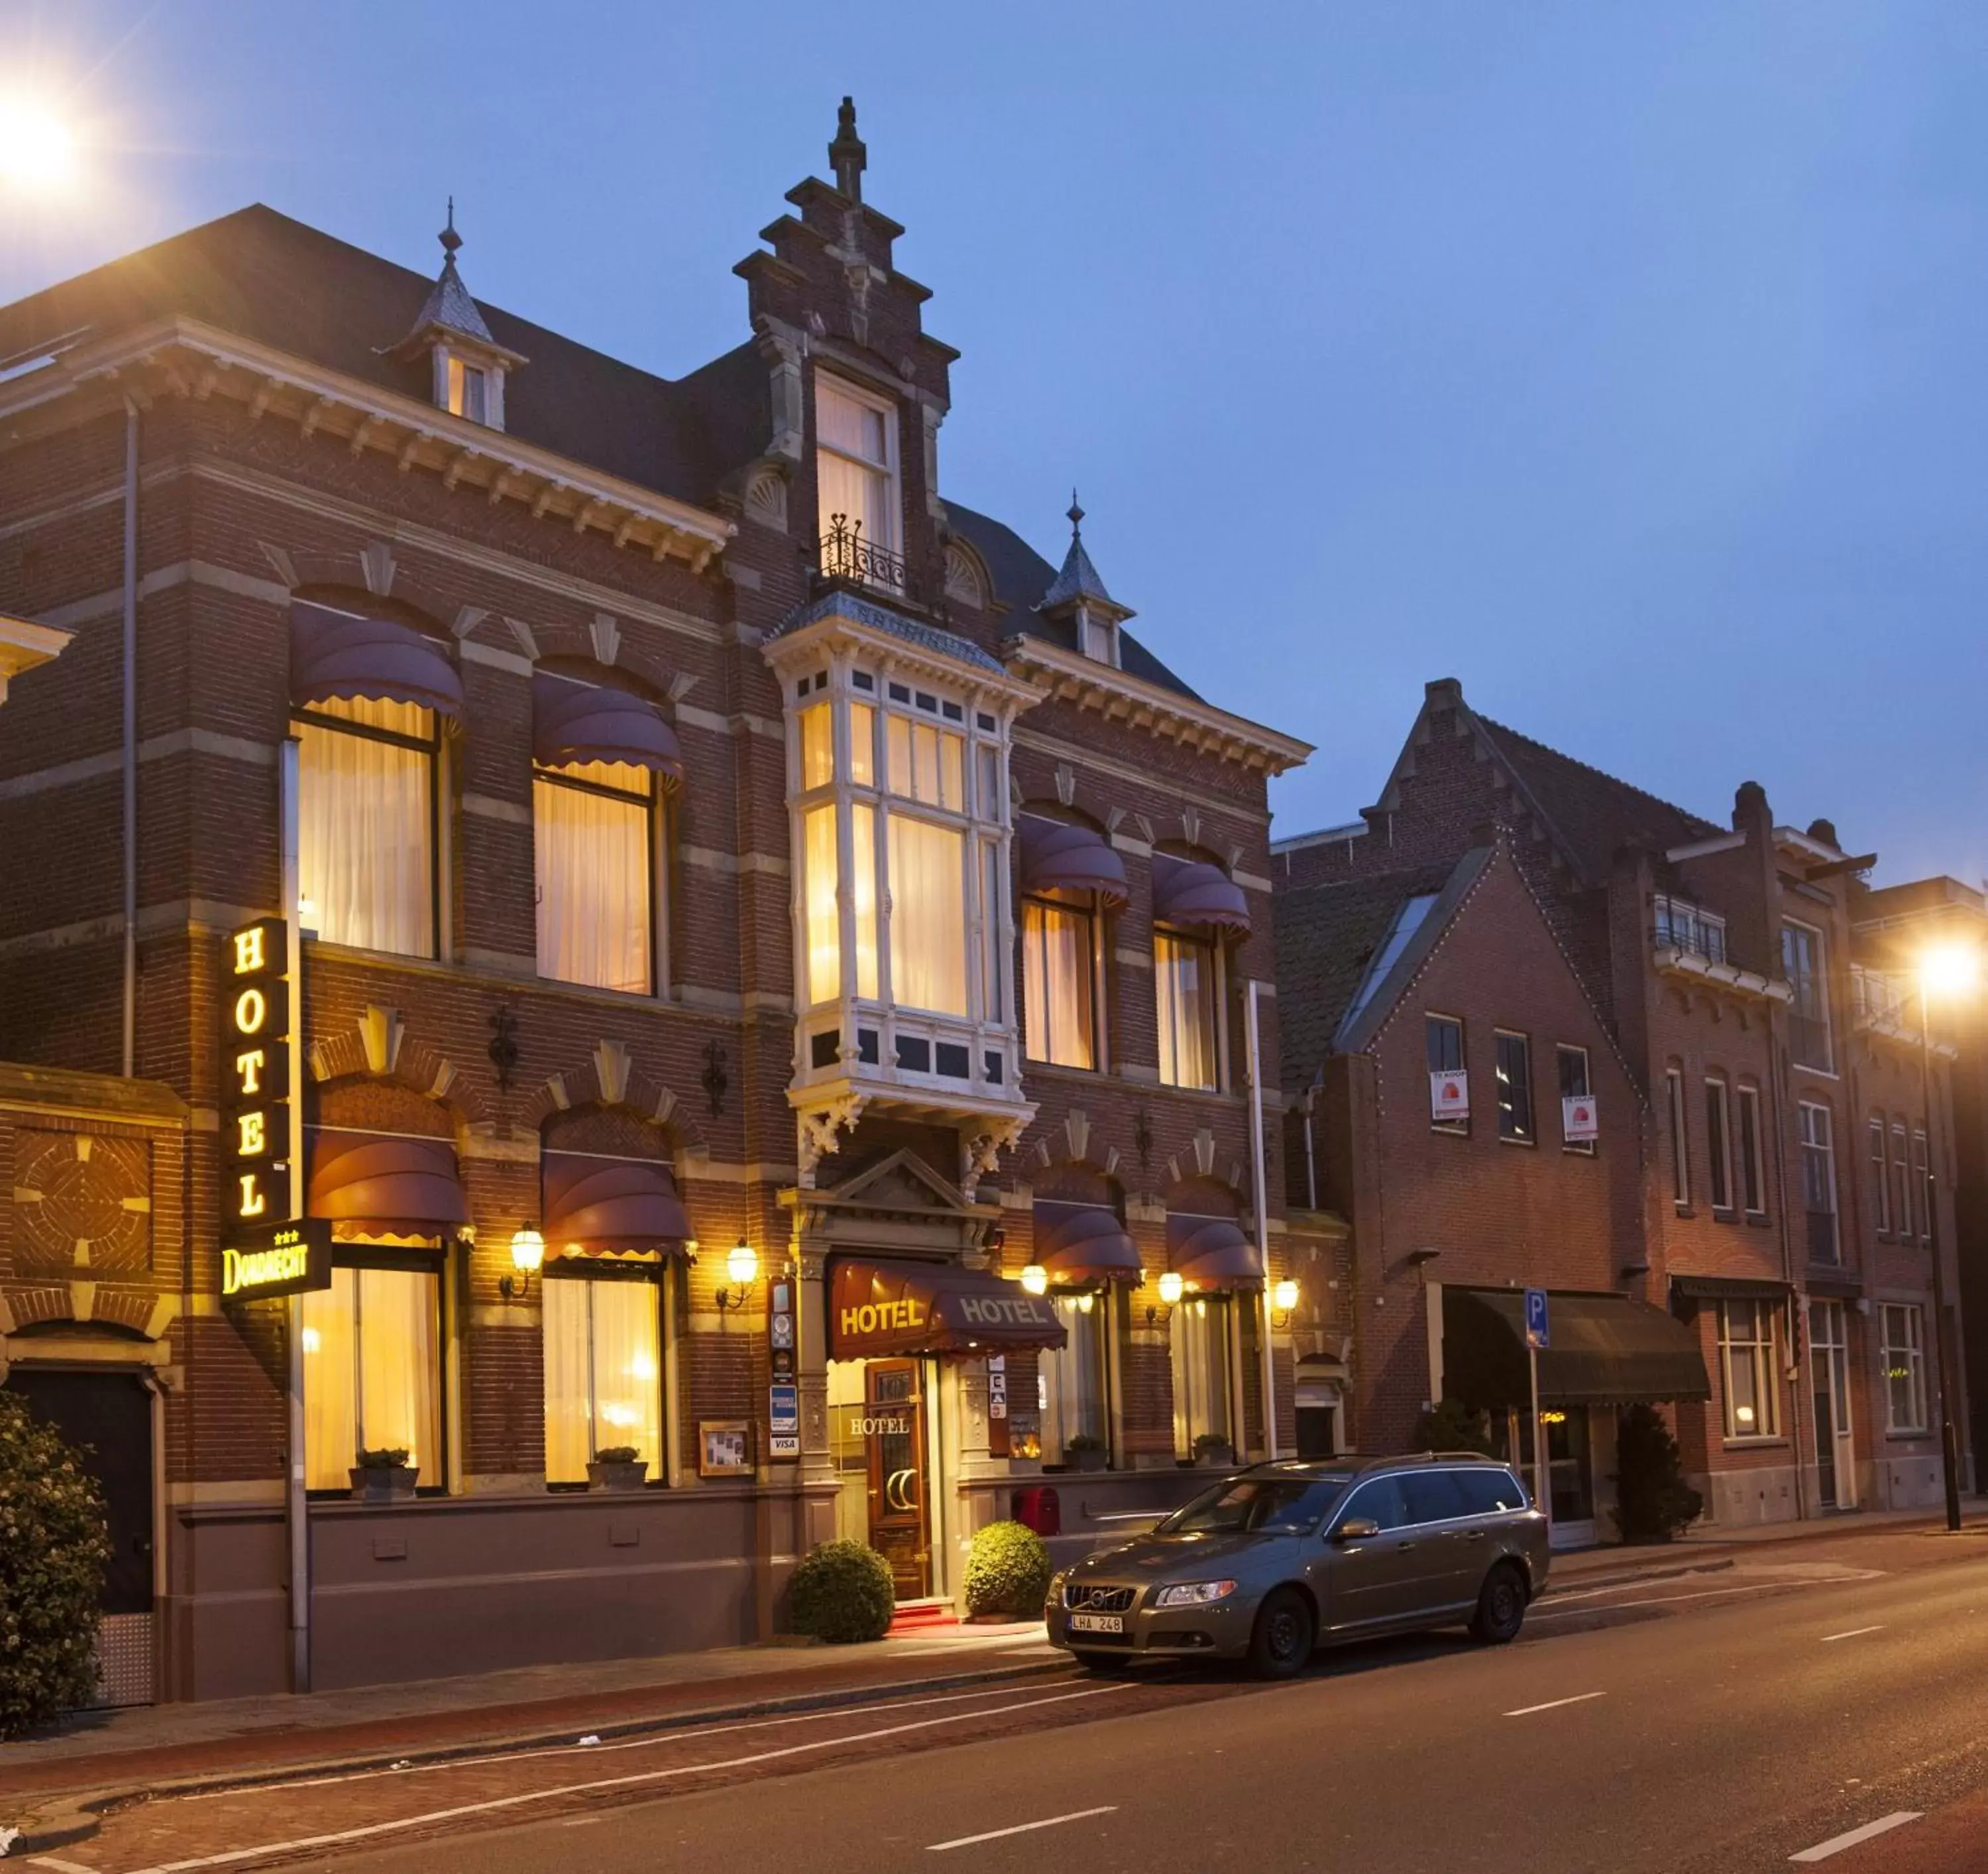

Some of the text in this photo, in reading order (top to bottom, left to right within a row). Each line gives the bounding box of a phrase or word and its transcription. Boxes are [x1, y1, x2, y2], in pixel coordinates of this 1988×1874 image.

[234, 926, 265, 1217] HOTEL
[841, 1298, 923, 1335] HOTEL
[960, 1297, 1048, 1324] HOTEL
[1531, 1295, 1543, 1323] P
[850, 1418, 910, 1435] HOTEL
[775, 1439, 795, 1449] VISA
[1074, 1616, 1121, 1631] LHA 248
